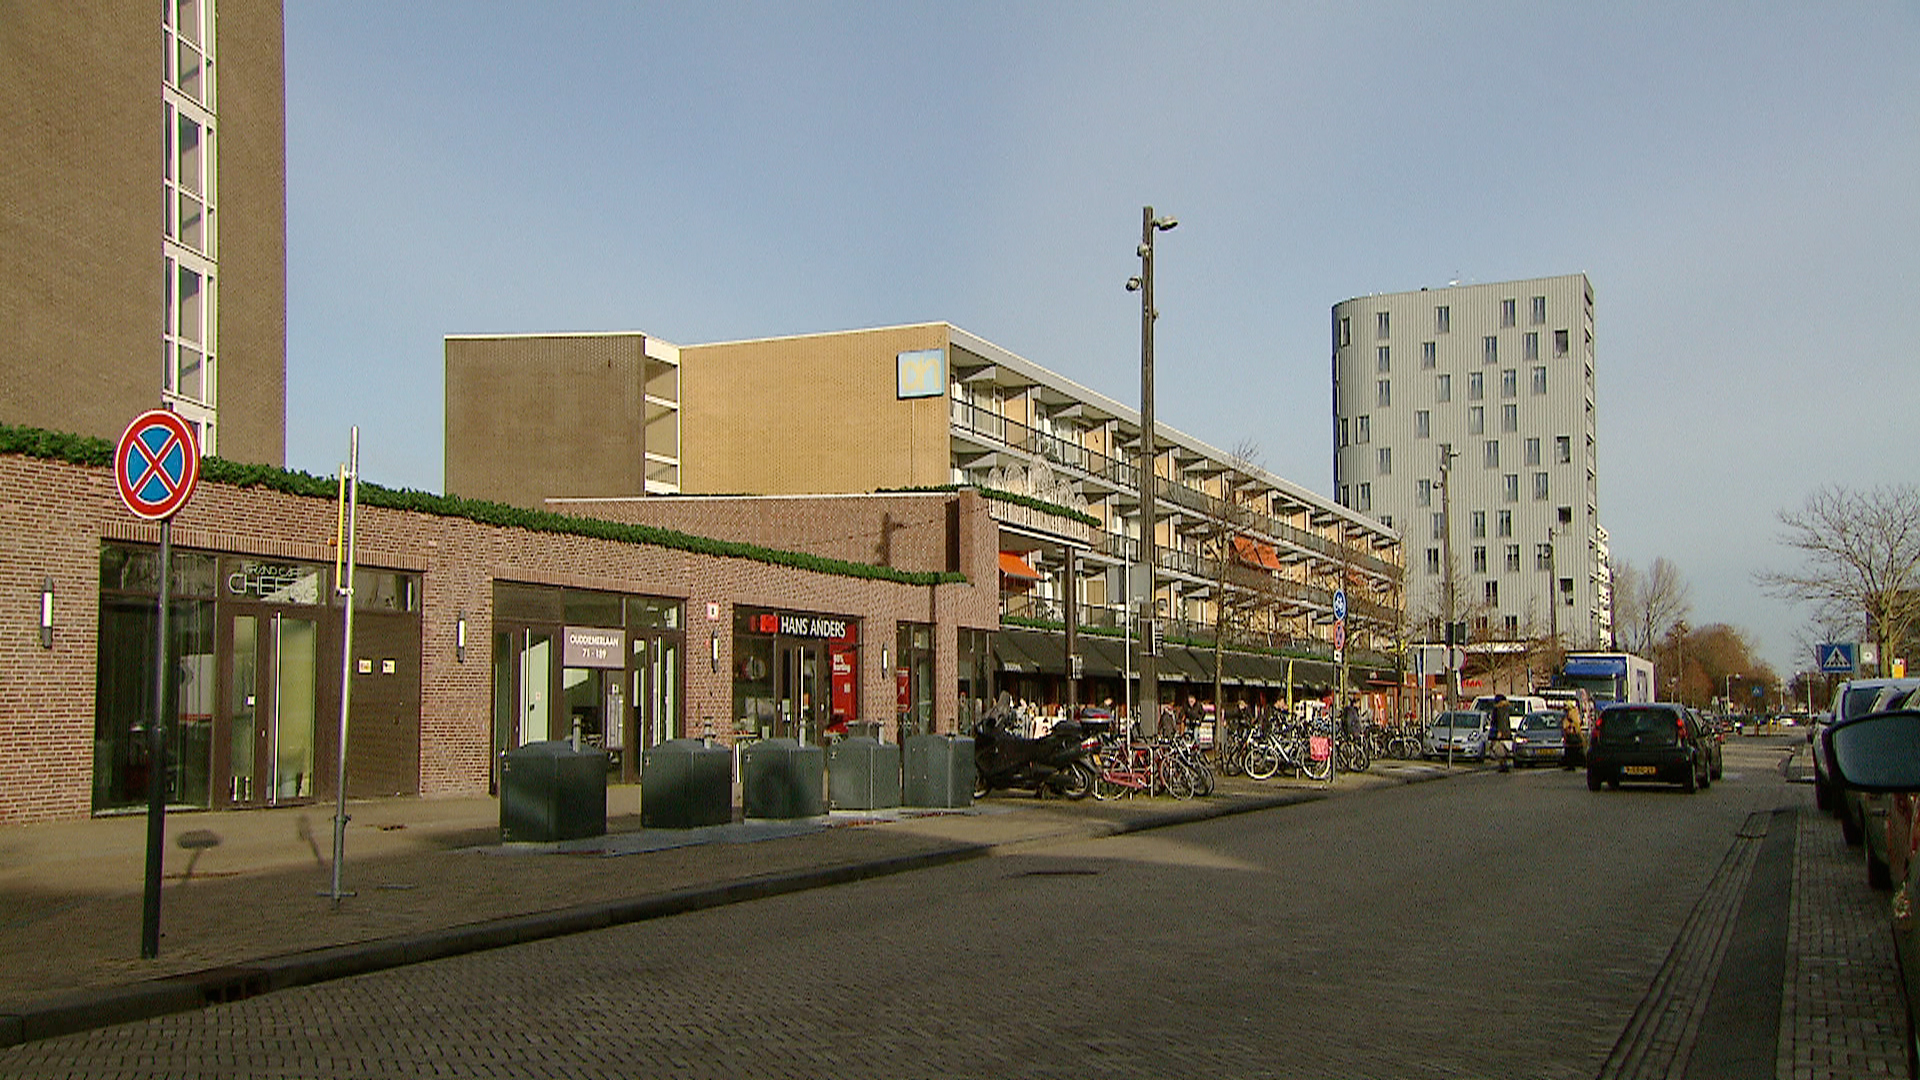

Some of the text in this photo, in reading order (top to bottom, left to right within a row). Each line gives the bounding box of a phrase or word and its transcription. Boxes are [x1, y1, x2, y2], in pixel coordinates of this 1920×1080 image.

[244, 564, 277, 575] GRAND
[781, 615, 846, 639] HANS ANDERS
